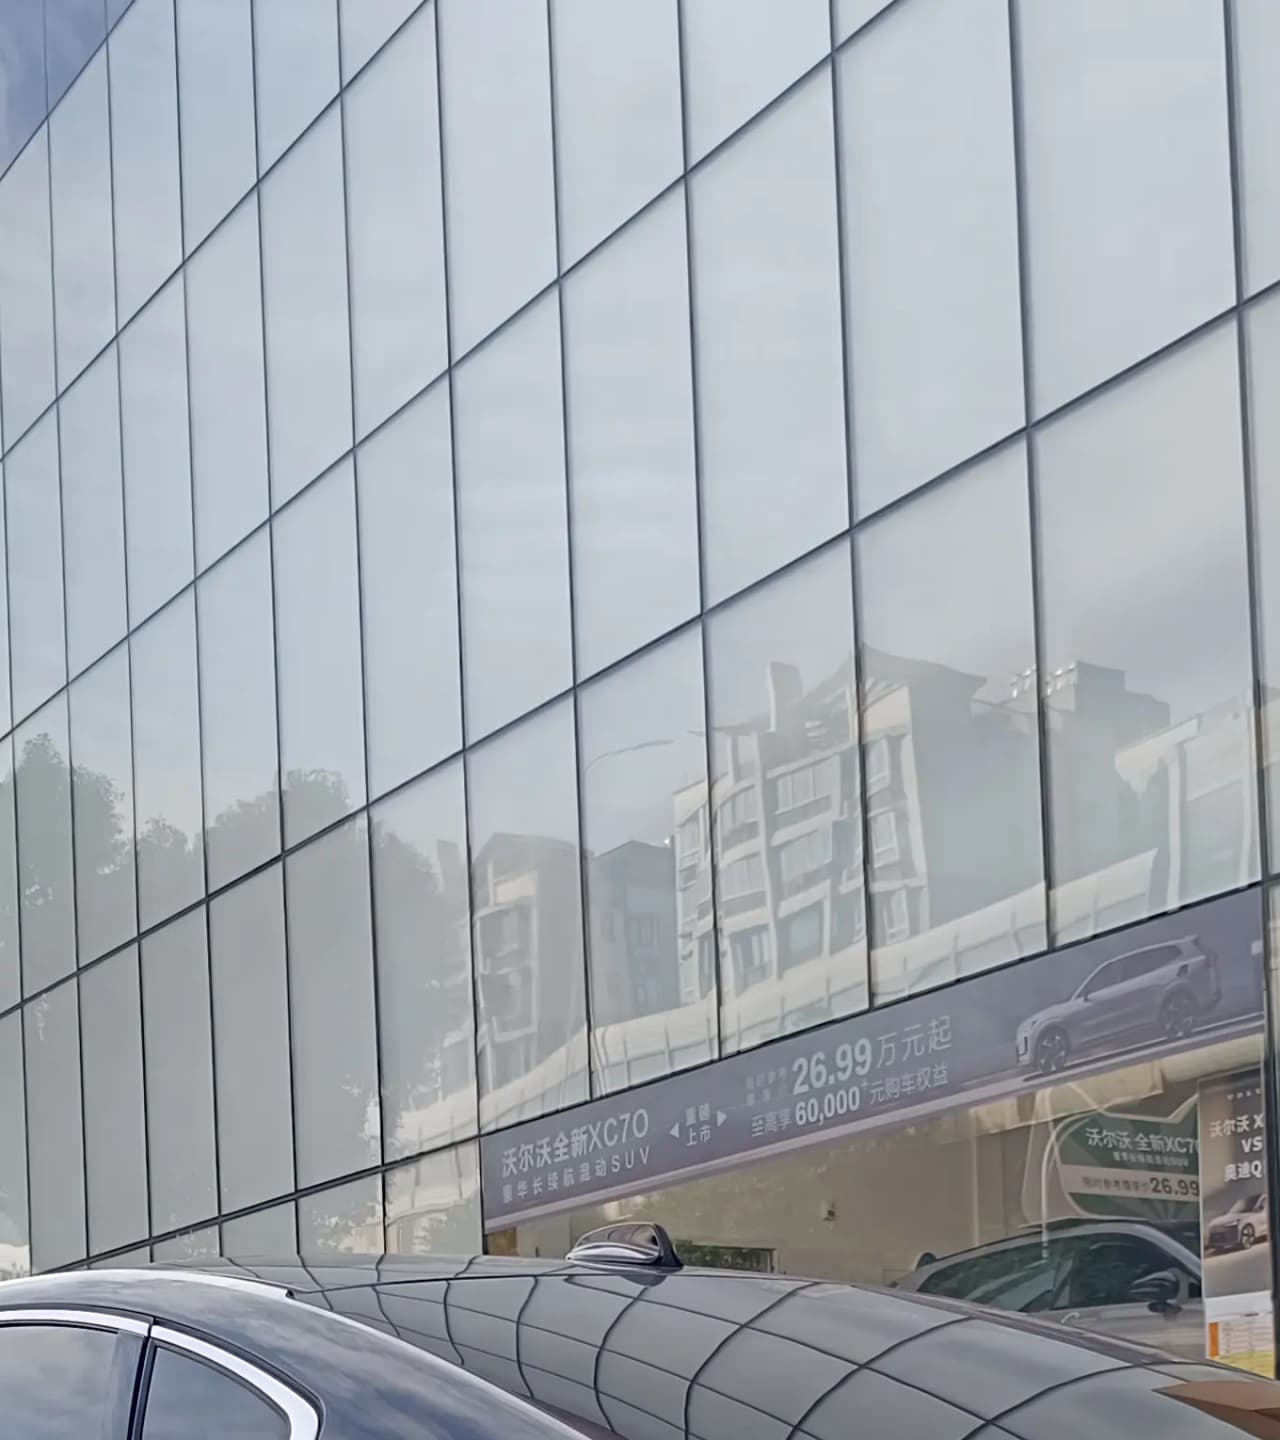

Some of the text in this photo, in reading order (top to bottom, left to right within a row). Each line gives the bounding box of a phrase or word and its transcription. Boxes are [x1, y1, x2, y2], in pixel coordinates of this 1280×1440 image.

[1208, 1114, 1250, 1138] 沃尔沃
[502, 1108, 649, 1178] 沃尔沃全新XC70
[1241, 1136, 1263, 1154] VS
